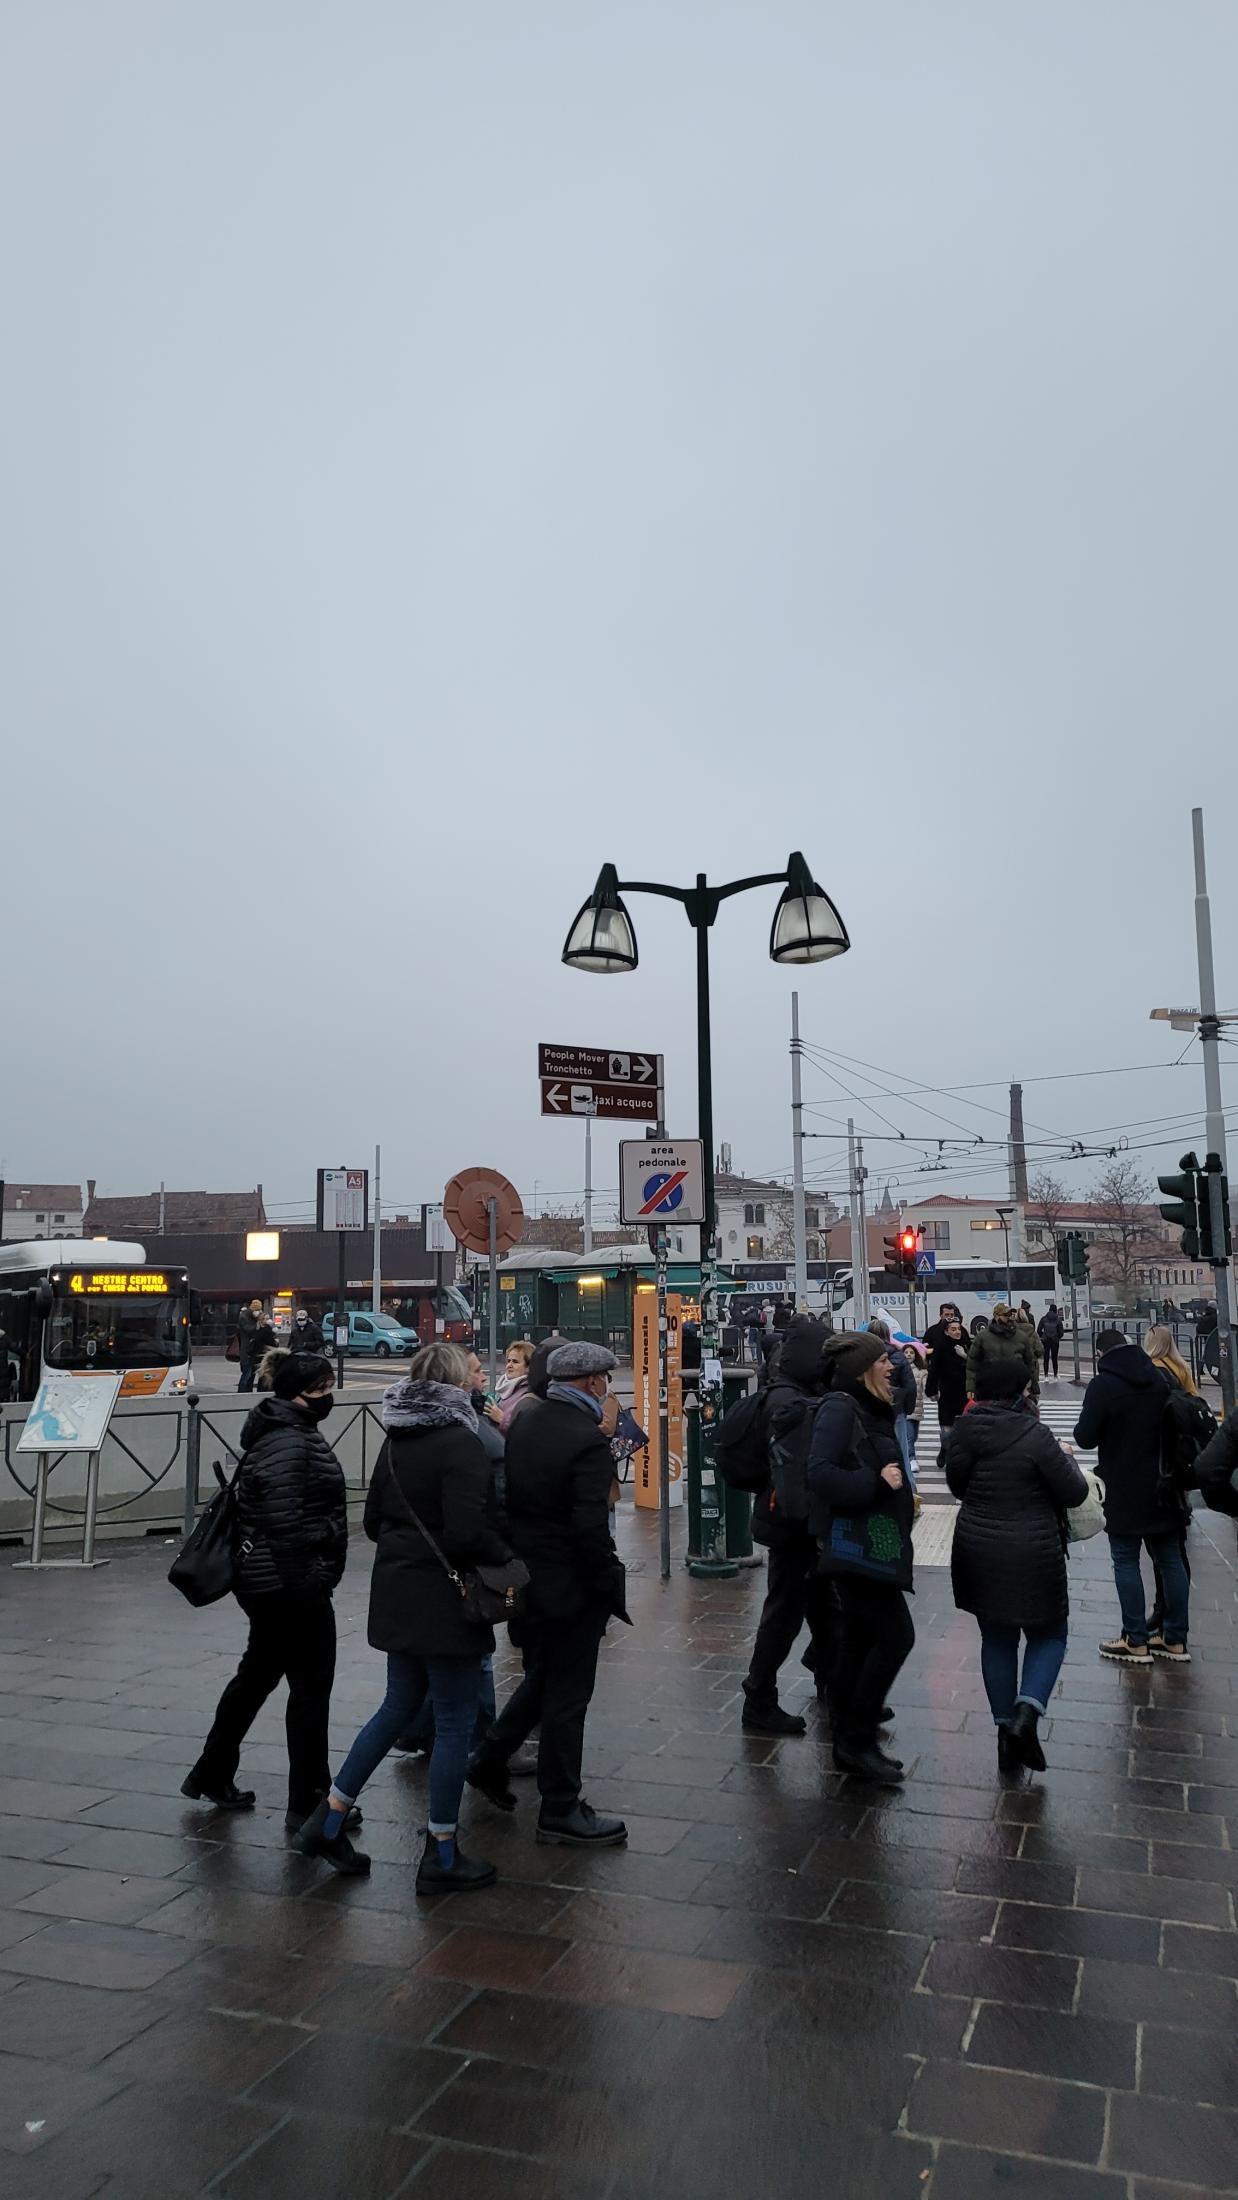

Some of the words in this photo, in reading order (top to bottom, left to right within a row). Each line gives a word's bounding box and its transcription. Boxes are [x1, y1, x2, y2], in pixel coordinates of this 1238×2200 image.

[544, 1048, 575, 1061] People
[578, 1051, 606, 1063] Mover
[544, 1062, 593, 1075] Tronchetto
[594, 1095, 614, 1106] taxi
[616, 1098, 653, 1109] acqueo
[638, 1157, 687, 1168] pedonale
[348, 1176, 361, 1186] A5
[92, 1275, 127, 1285] MESTRE
[129, 1275, 164, 1285] CENTRO
